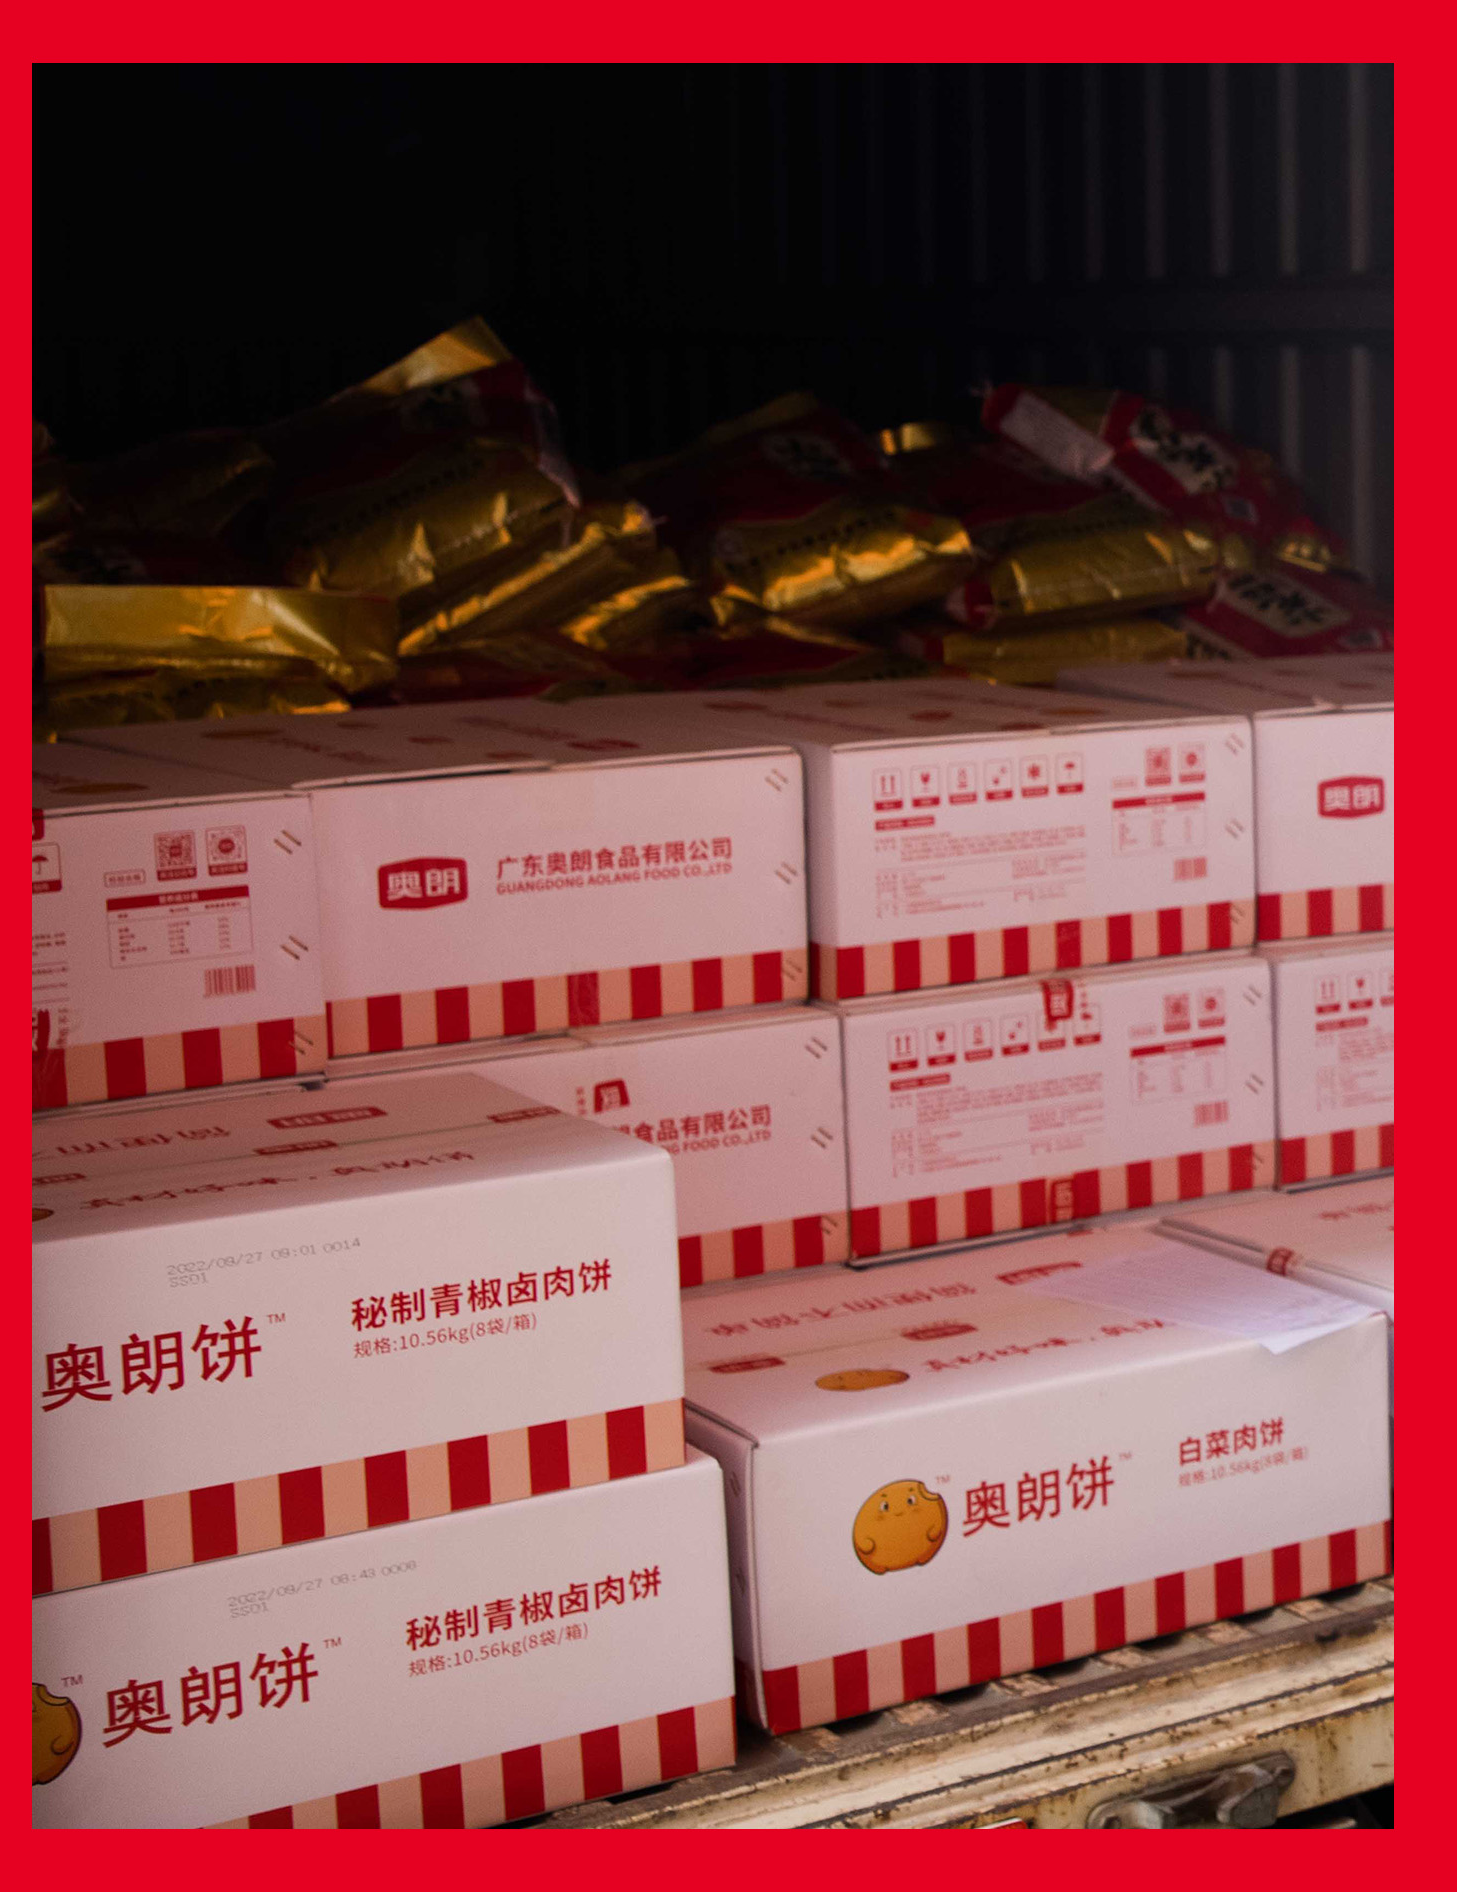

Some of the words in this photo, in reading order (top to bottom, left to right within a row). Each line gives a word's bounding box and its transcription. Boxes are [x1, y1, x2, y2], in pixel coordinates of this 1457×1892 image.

[496, 876, 584, 895] GUANGDONG
[587, 869, 642, 886] AOLANG
[643, 866, 681, 881] FOOD
[497, 837, 732, 880] 广东奥朗食品有限公司
[386, 868, 461, 901] 奥朗
[616, 1104, 772, 1144] 食品有限公司
[683, 1136, 721, 1152] FOOD
[351, 1258, 612, 1332] 秘制青椒卤肉饼
[41, 1316, 262, 1413] 奥朗饼
[1179, 1416, 1284, 1466] 白菜肉饼
[962, 1455, 1115, 1537] 奥朗饼
[405, 1565, 662, 1651] 秘制青椒卤肉饼
[103, 1642, 319, 1748] 奥朗饼
